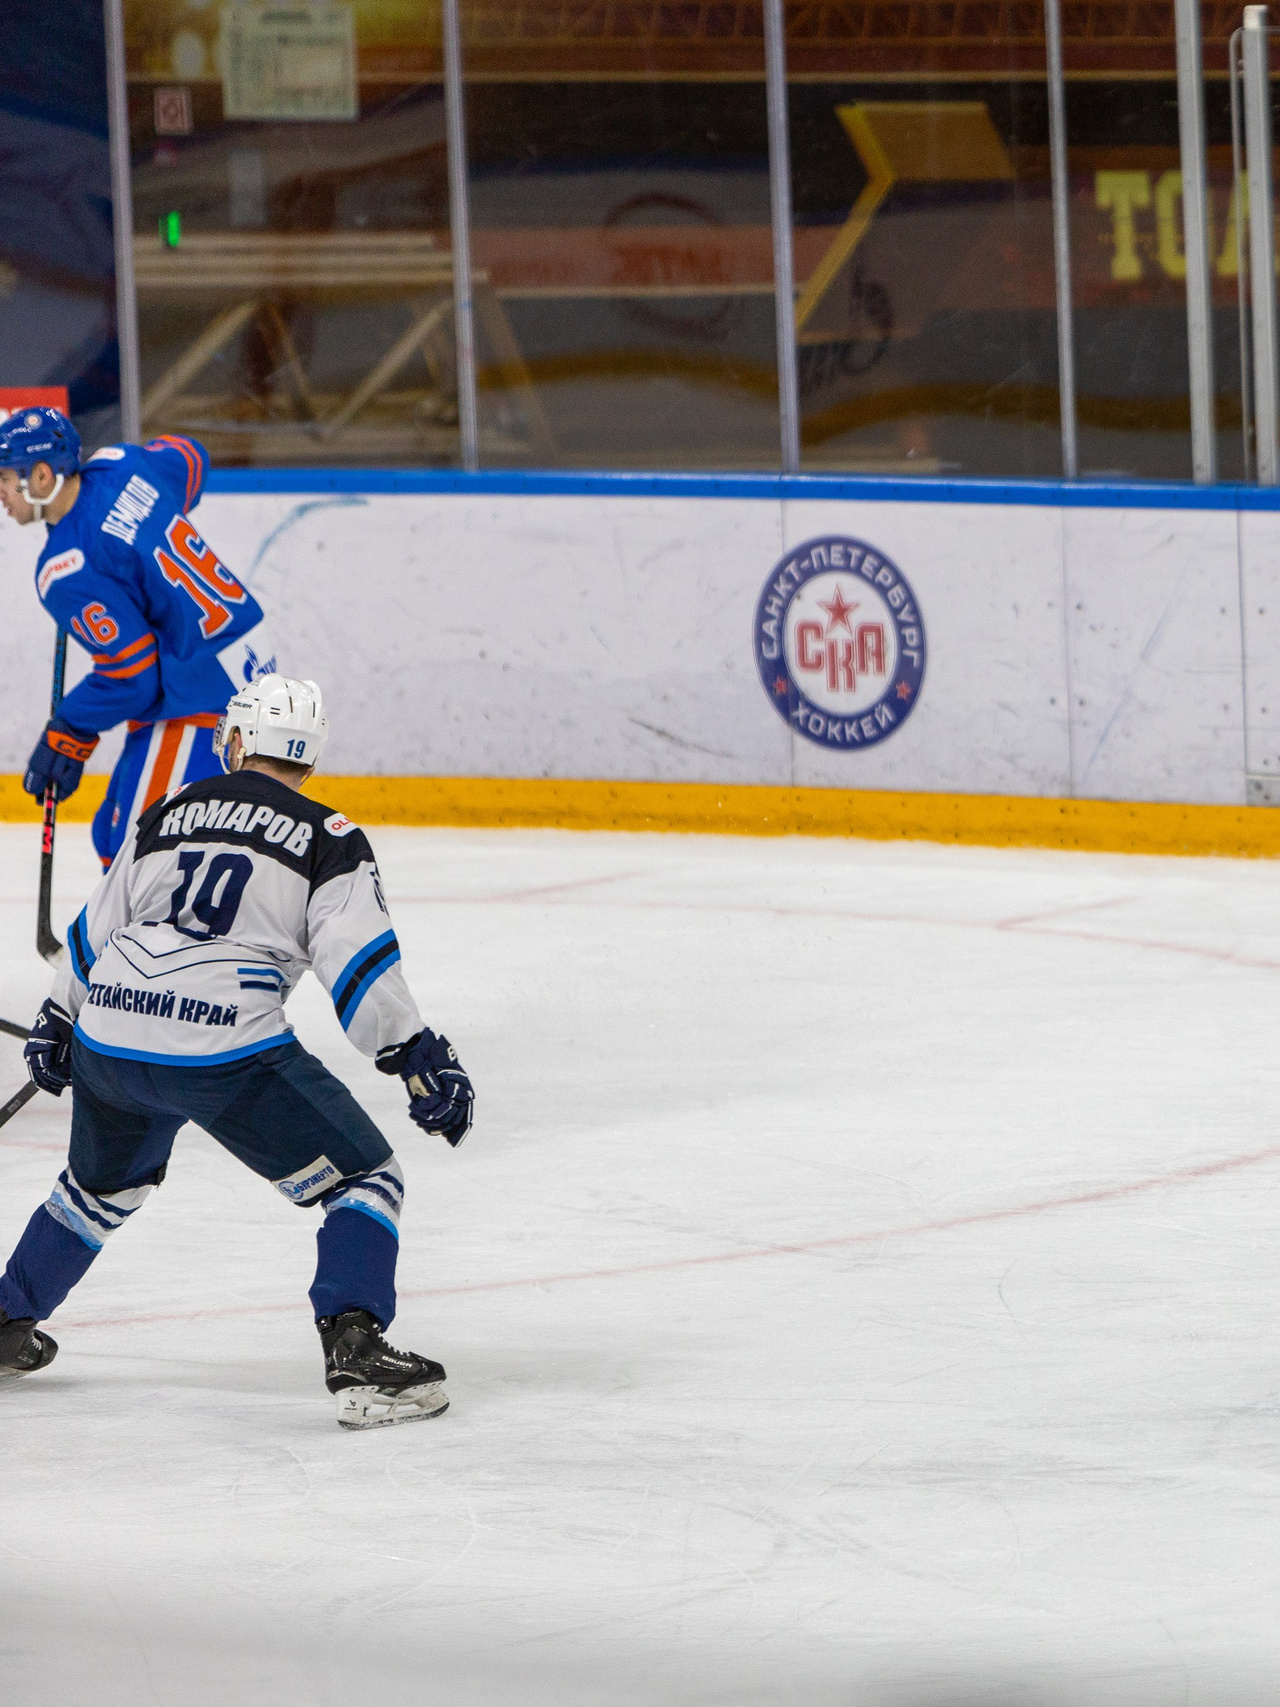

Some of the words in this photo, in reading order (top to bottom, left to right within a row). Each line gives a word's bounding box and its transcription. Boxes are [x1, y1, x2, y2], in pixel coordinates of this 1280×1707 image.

[101, 474, 160, 546] ДЕМИДОВ
[153, 513, 248, 639] 16
[70, 601, 120, 649] 16
[761, 544, 920, 669] САНКТ-ПЕТЕРБУРГ
[794, 620, 886, 693] СКА
[286, 738, 307, 759] 19
[791, 700, 895, 743] ХОККЕЙ
[159, 799, 313, 857] КОМАРОВ
[87, 982, 176, 1019] ЛТАЙСКИЙ
[178, 997, 239, 1027] КРАЙ
